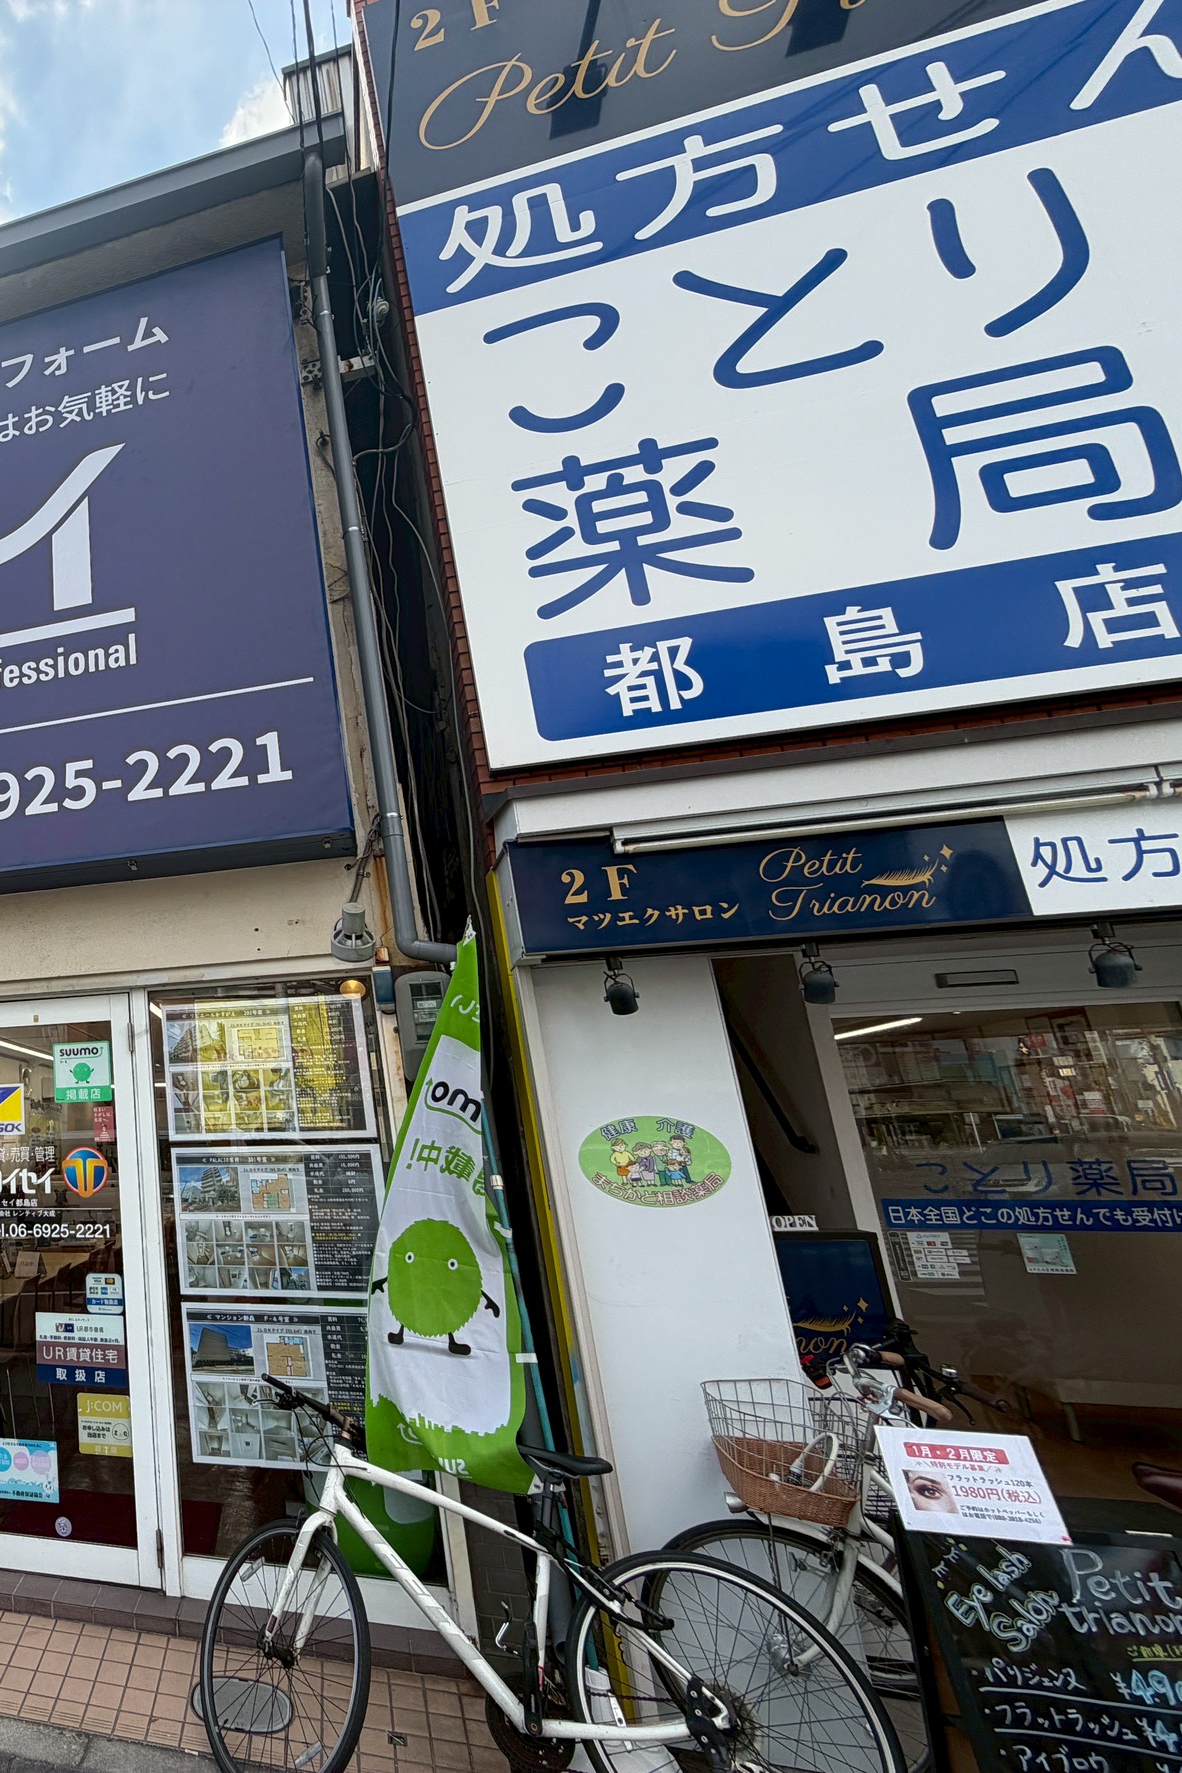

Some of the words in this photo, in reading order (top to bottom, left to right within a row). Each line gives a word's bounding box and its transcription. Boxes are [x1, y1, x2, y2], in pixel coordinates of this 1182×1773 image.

[418, 17, 677, 150] Petit
[483, 167, 1090, 434] ことり
[511, 345, 1182, 620] 薬局
[604, 563, 1182, 717] 都島店
[759, 846, 863, 883] Petit
[1031, 828, 1181, 888] 処方
[567, 902, 739, 930] マツエクサロン
[769, 883, 936, 921] Trianon
[66, 1089, 101, 1100] 掲載店
[600, 1118, 638, 1141] 健康
[656, 1118, 696, 1139] 介護
[592, 1172, 724, 1206] まちかど相談薬局
[916, 1158, 1178, 1196] ことり薬局
[772, 1215, 817, 1230] OPEN
[43, 1346, 118, 1363] UR賃貸住宅
[56, 1368, 106, 1383] 取扱店
[86, 1400, 123, 1413] J:COM
[952, 1485, 1042, 1505] 1980円(税込)
[1059, 1549, 1182, 1609] Petit
[990, 1590, 1059, 1652] Salon
